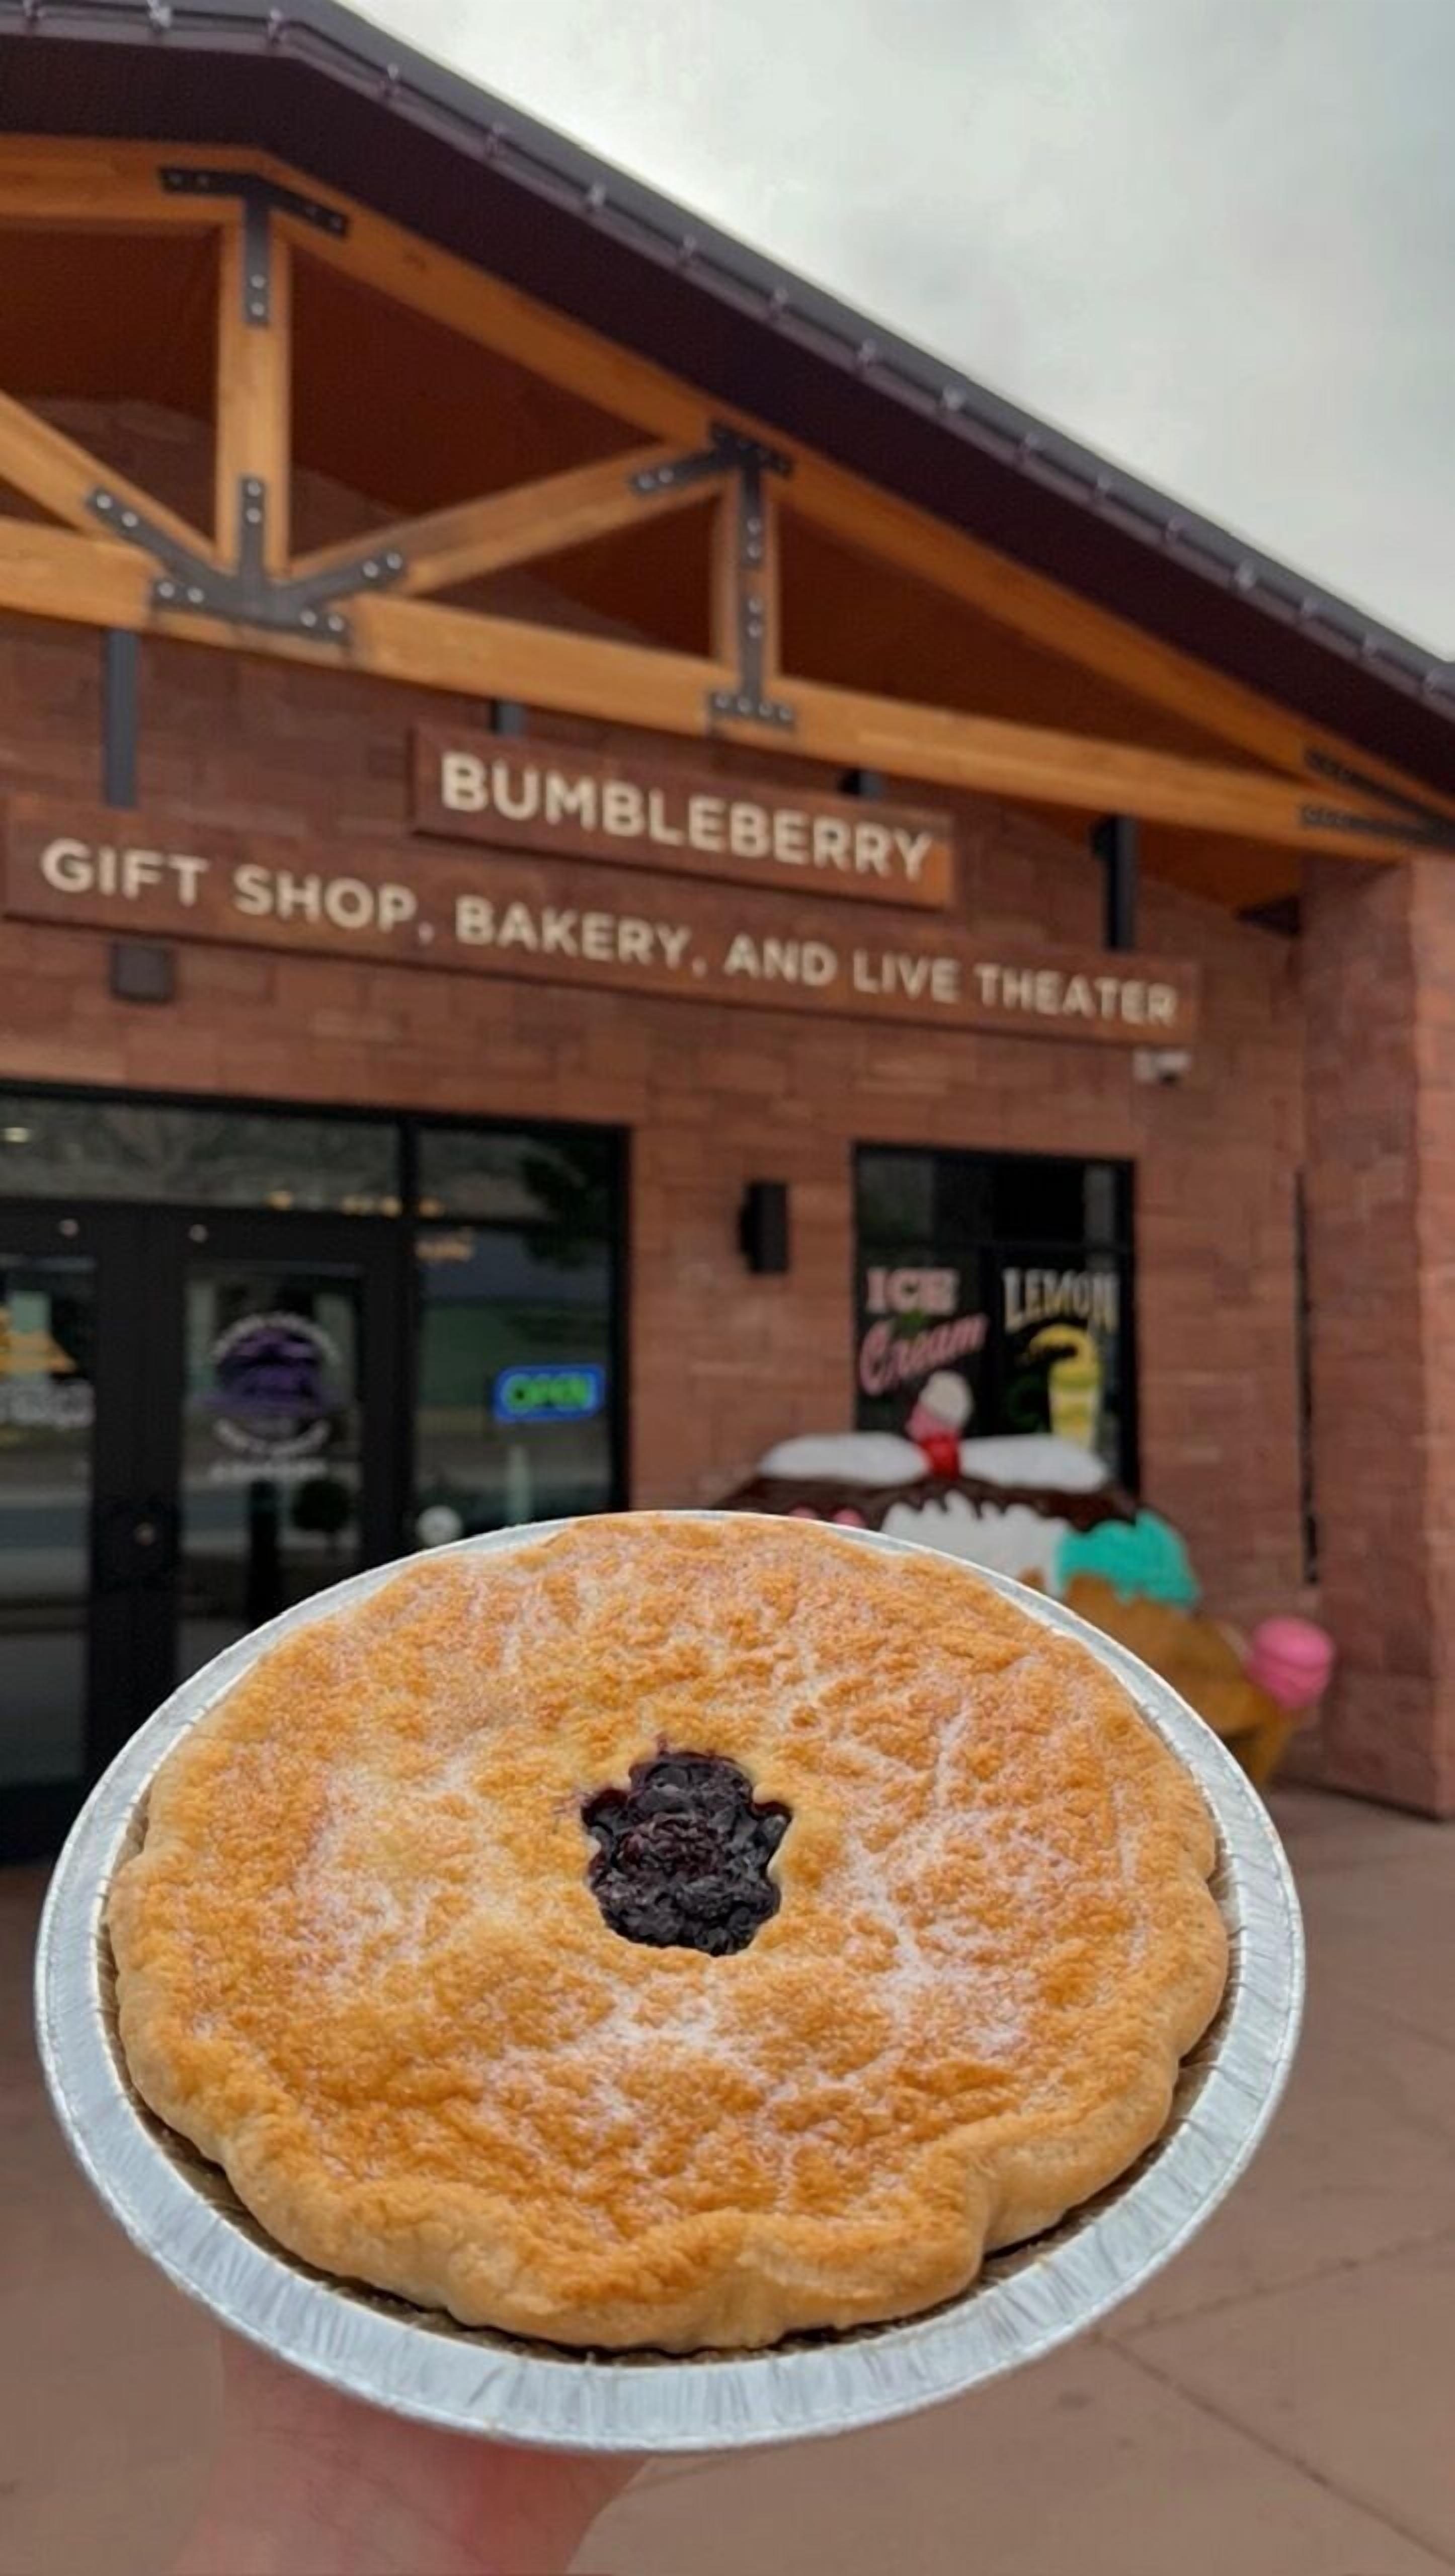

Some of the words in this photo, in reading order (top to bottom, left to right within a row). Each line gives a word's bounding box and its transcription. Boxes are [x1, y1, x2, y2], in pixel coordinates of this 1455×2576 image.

[440, 751, 933, 881] BUMBLEBERRY
[40, 837, 210, 907] GIFT
[232, 863, 434, 945] SHOP,
[454, 896, 708, 976] BAKERY,
[723, 933, 837, 987] AND
[853, 949, 960, 1004] LIVE
[974, 964, 1179, 1027] THEATER
[866, 1267, 959, 1315] ICE
[1003, 1267, 1120, 1334] LEMON
[858, 1312, 989, 1396] Cream
